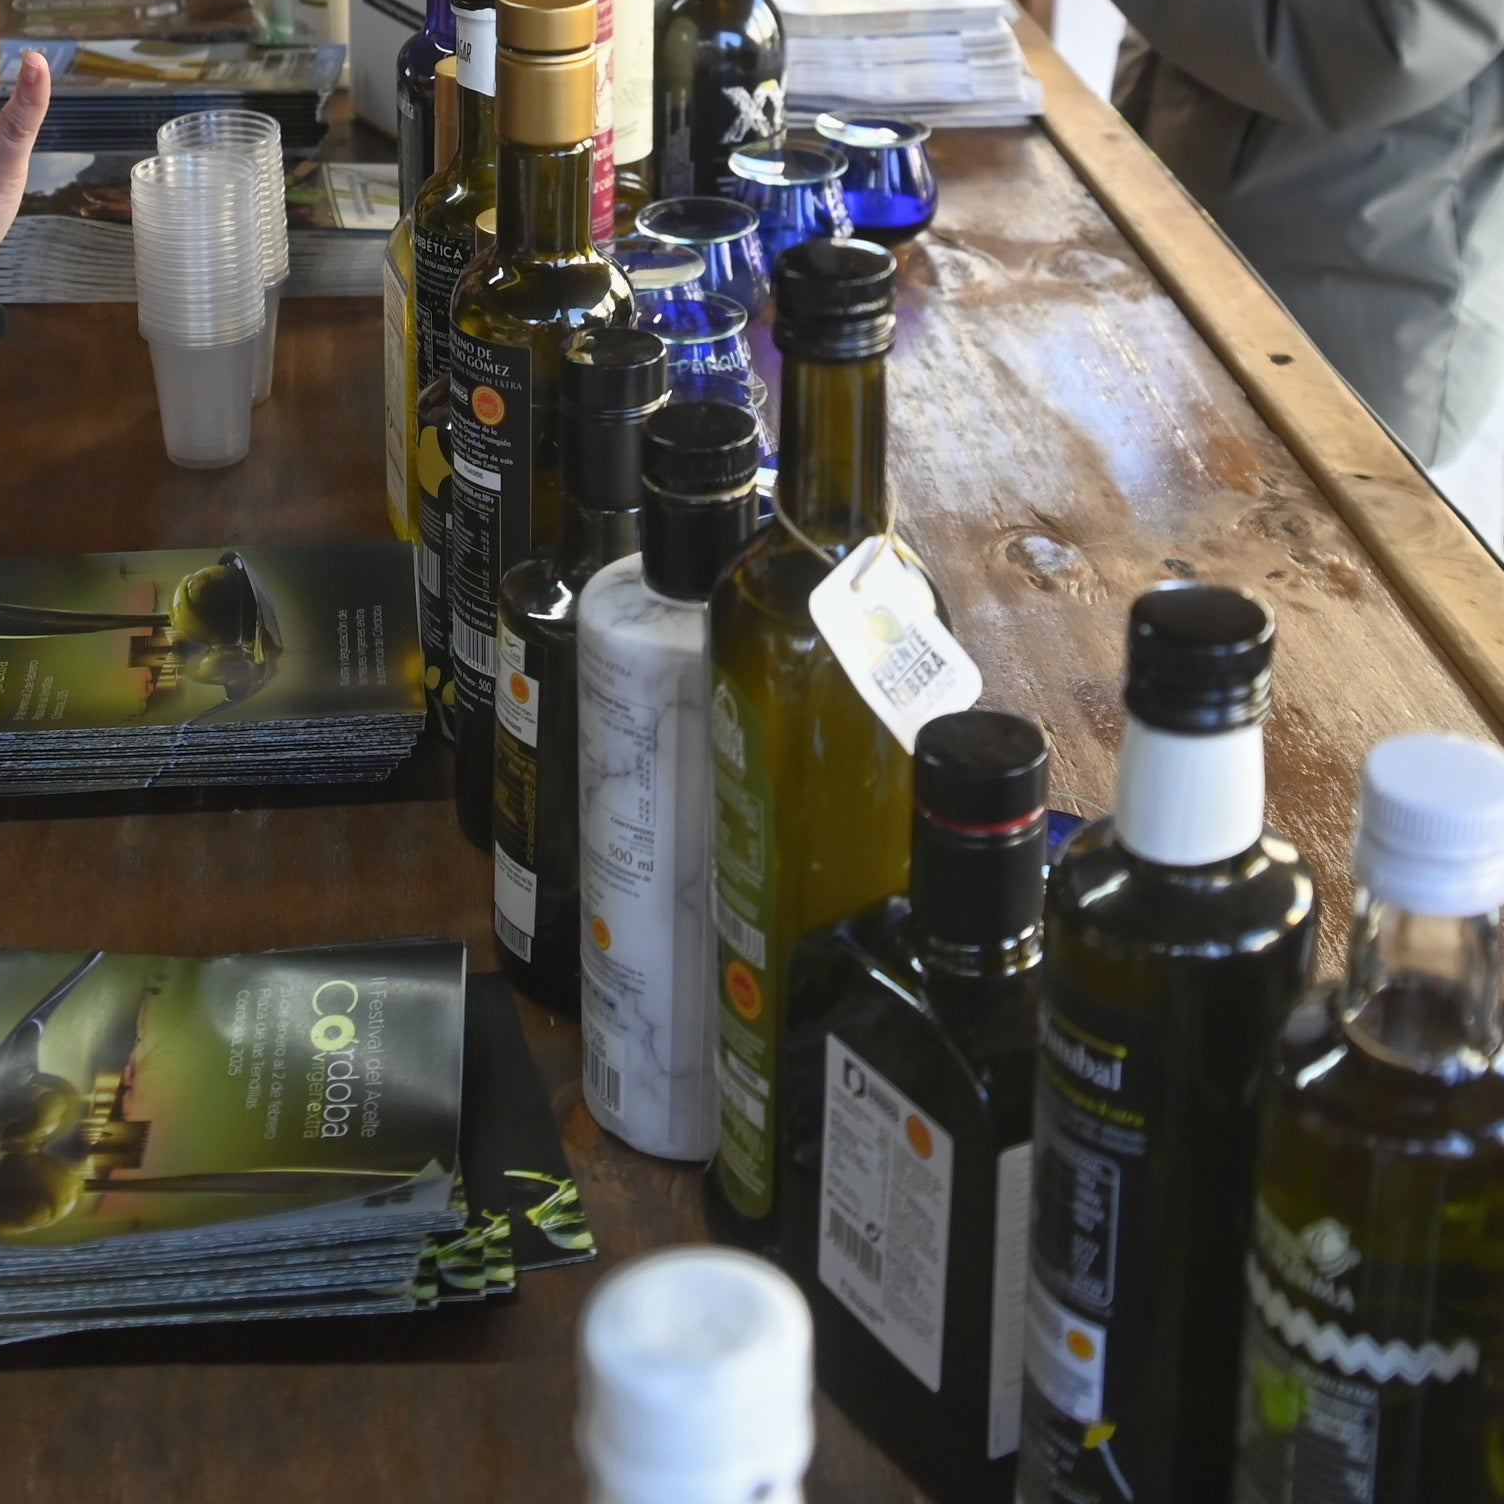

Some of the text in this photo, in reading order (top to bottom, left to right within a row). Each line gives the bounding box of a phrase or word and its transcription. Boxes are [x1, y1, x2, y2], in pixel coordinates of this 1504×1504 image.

[415, 235, 463, 261] BBÉTICA
[467, 356, 510, 377] GÓMEZ
[477, 347, 492, 360] DE
[495, 379, 523, 391] EXTRA
[872, 624, 928, 689] FUENTE
[478, 678, 491, 693] 500
[608, 843, 654, 872] 500 ml
[367, 989, 387, 1053] Festival
[245, 988, 272, 1110] Plaza de las Tendillas
[273, 1020, 290, 1057] enero
[228, 1048, 245, 1076] 2025
[273, 1060, 287, 1070] al
[310, 980, 360, 1139] Córdoba
[364, 1057, 385, 1086] del
[270, 1082, 285, 1098] de
[271, 1072, 285, 1080] 2
[303, 1052, 327, 1139] virgenextra
[263, 1100, 284, 1140] febrero
[360, 1090, 382, 1138] Aceite
